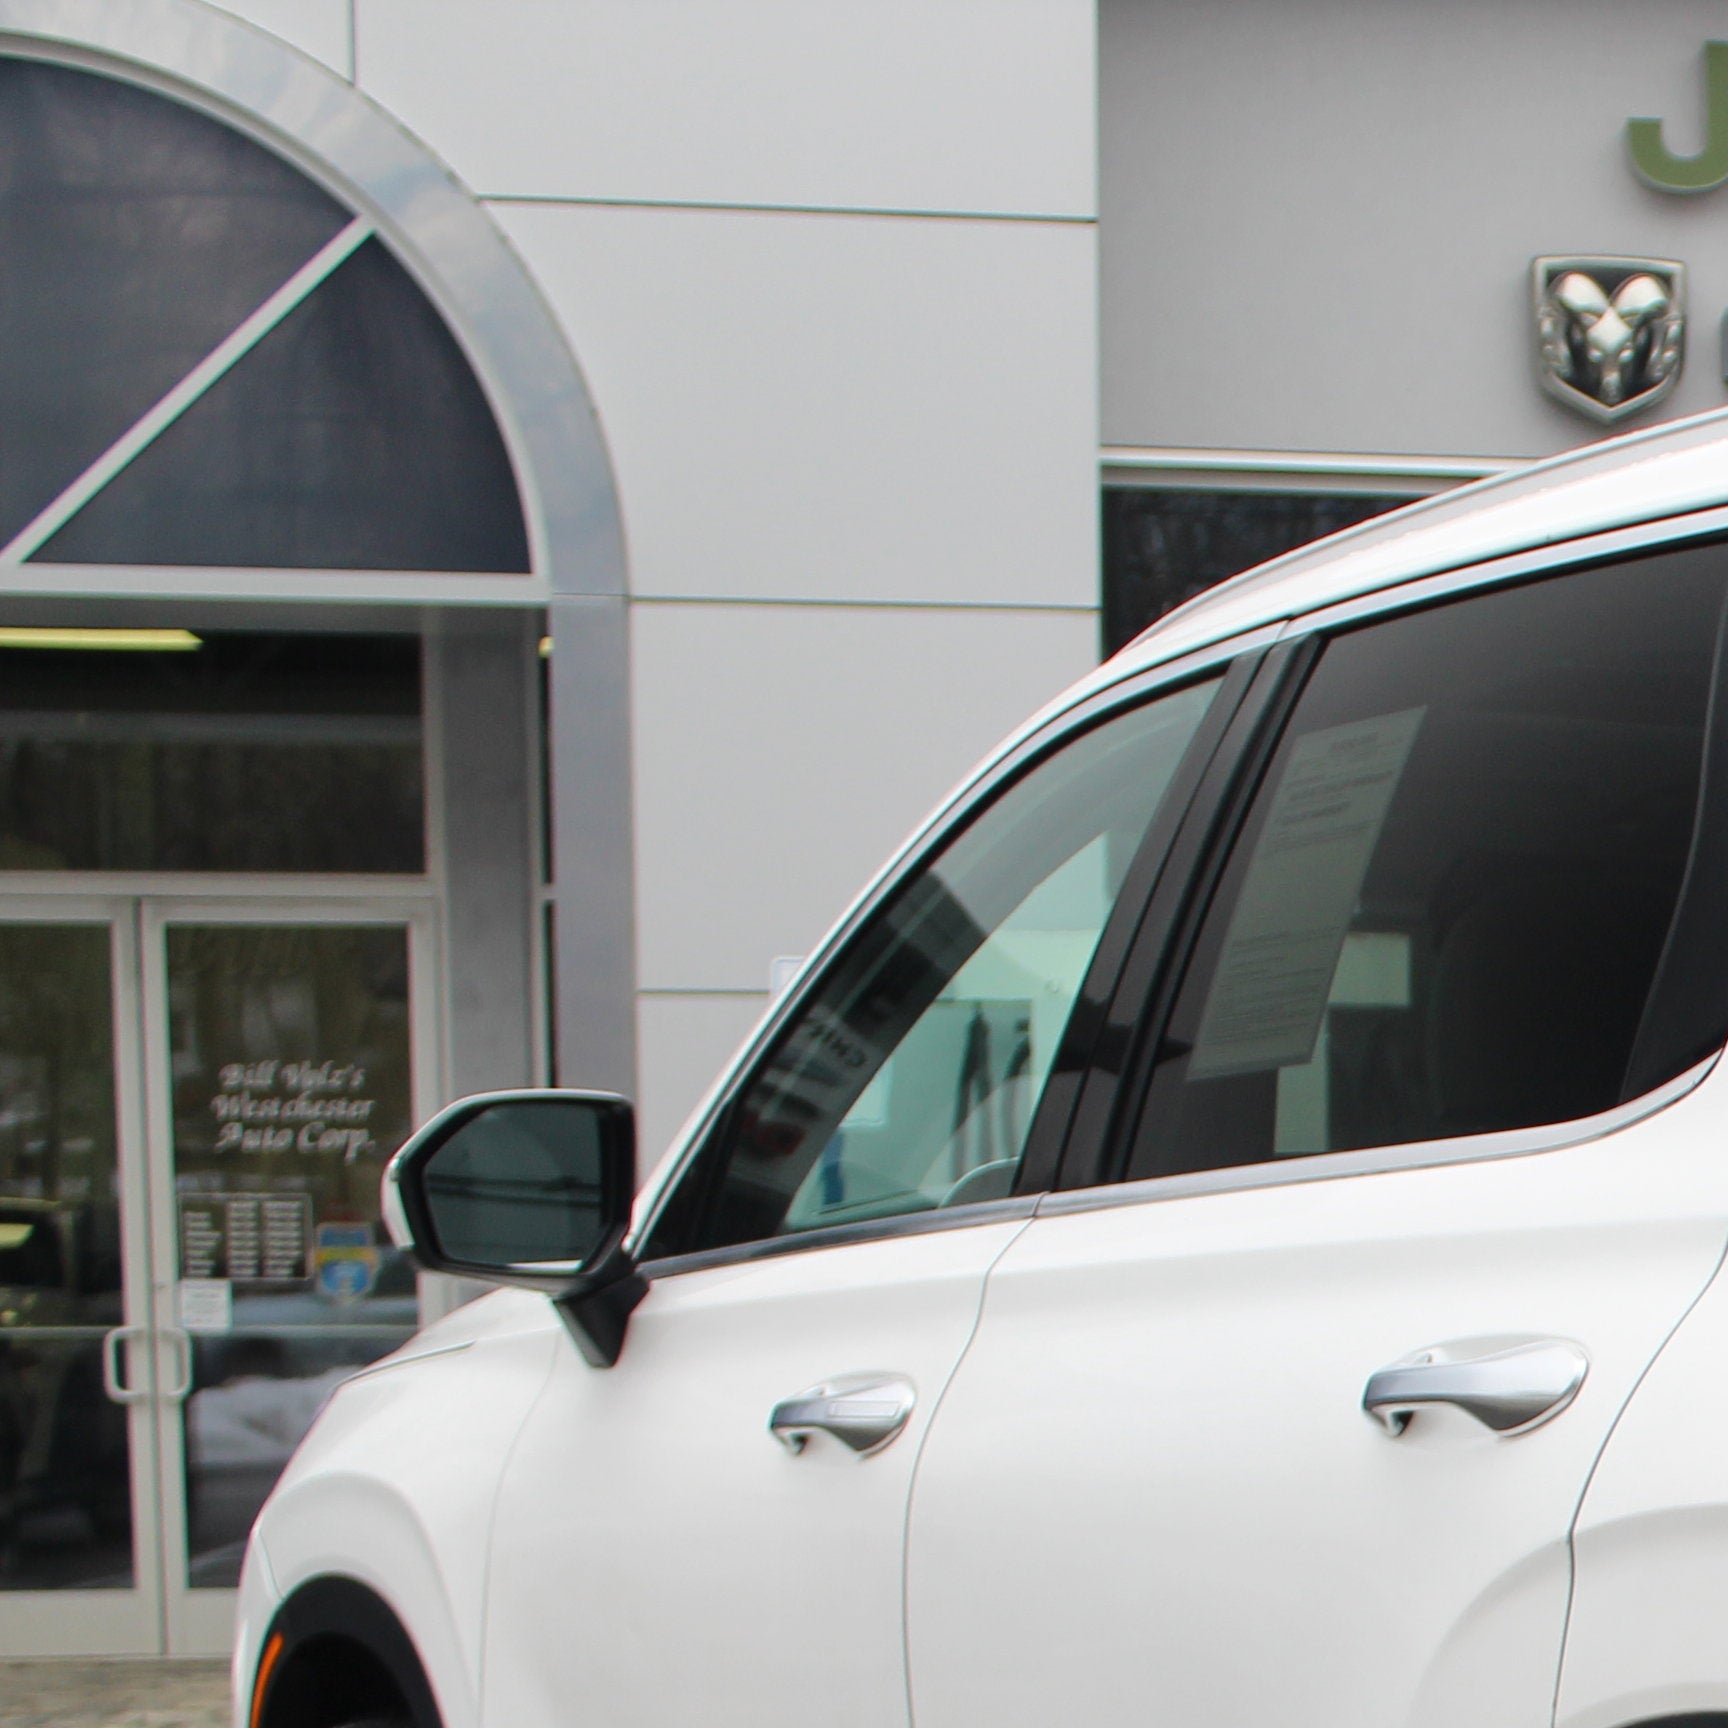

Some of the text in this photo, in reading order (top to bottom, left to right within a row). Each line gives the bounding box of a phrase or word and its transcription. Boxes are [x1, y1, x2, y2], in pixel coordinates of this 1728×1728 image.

[218, 1059, 281, 1091] Bill
[210, 1090, 377, 1121] Westchester
[214, 1120, 377, 1166] Auto Corp.
